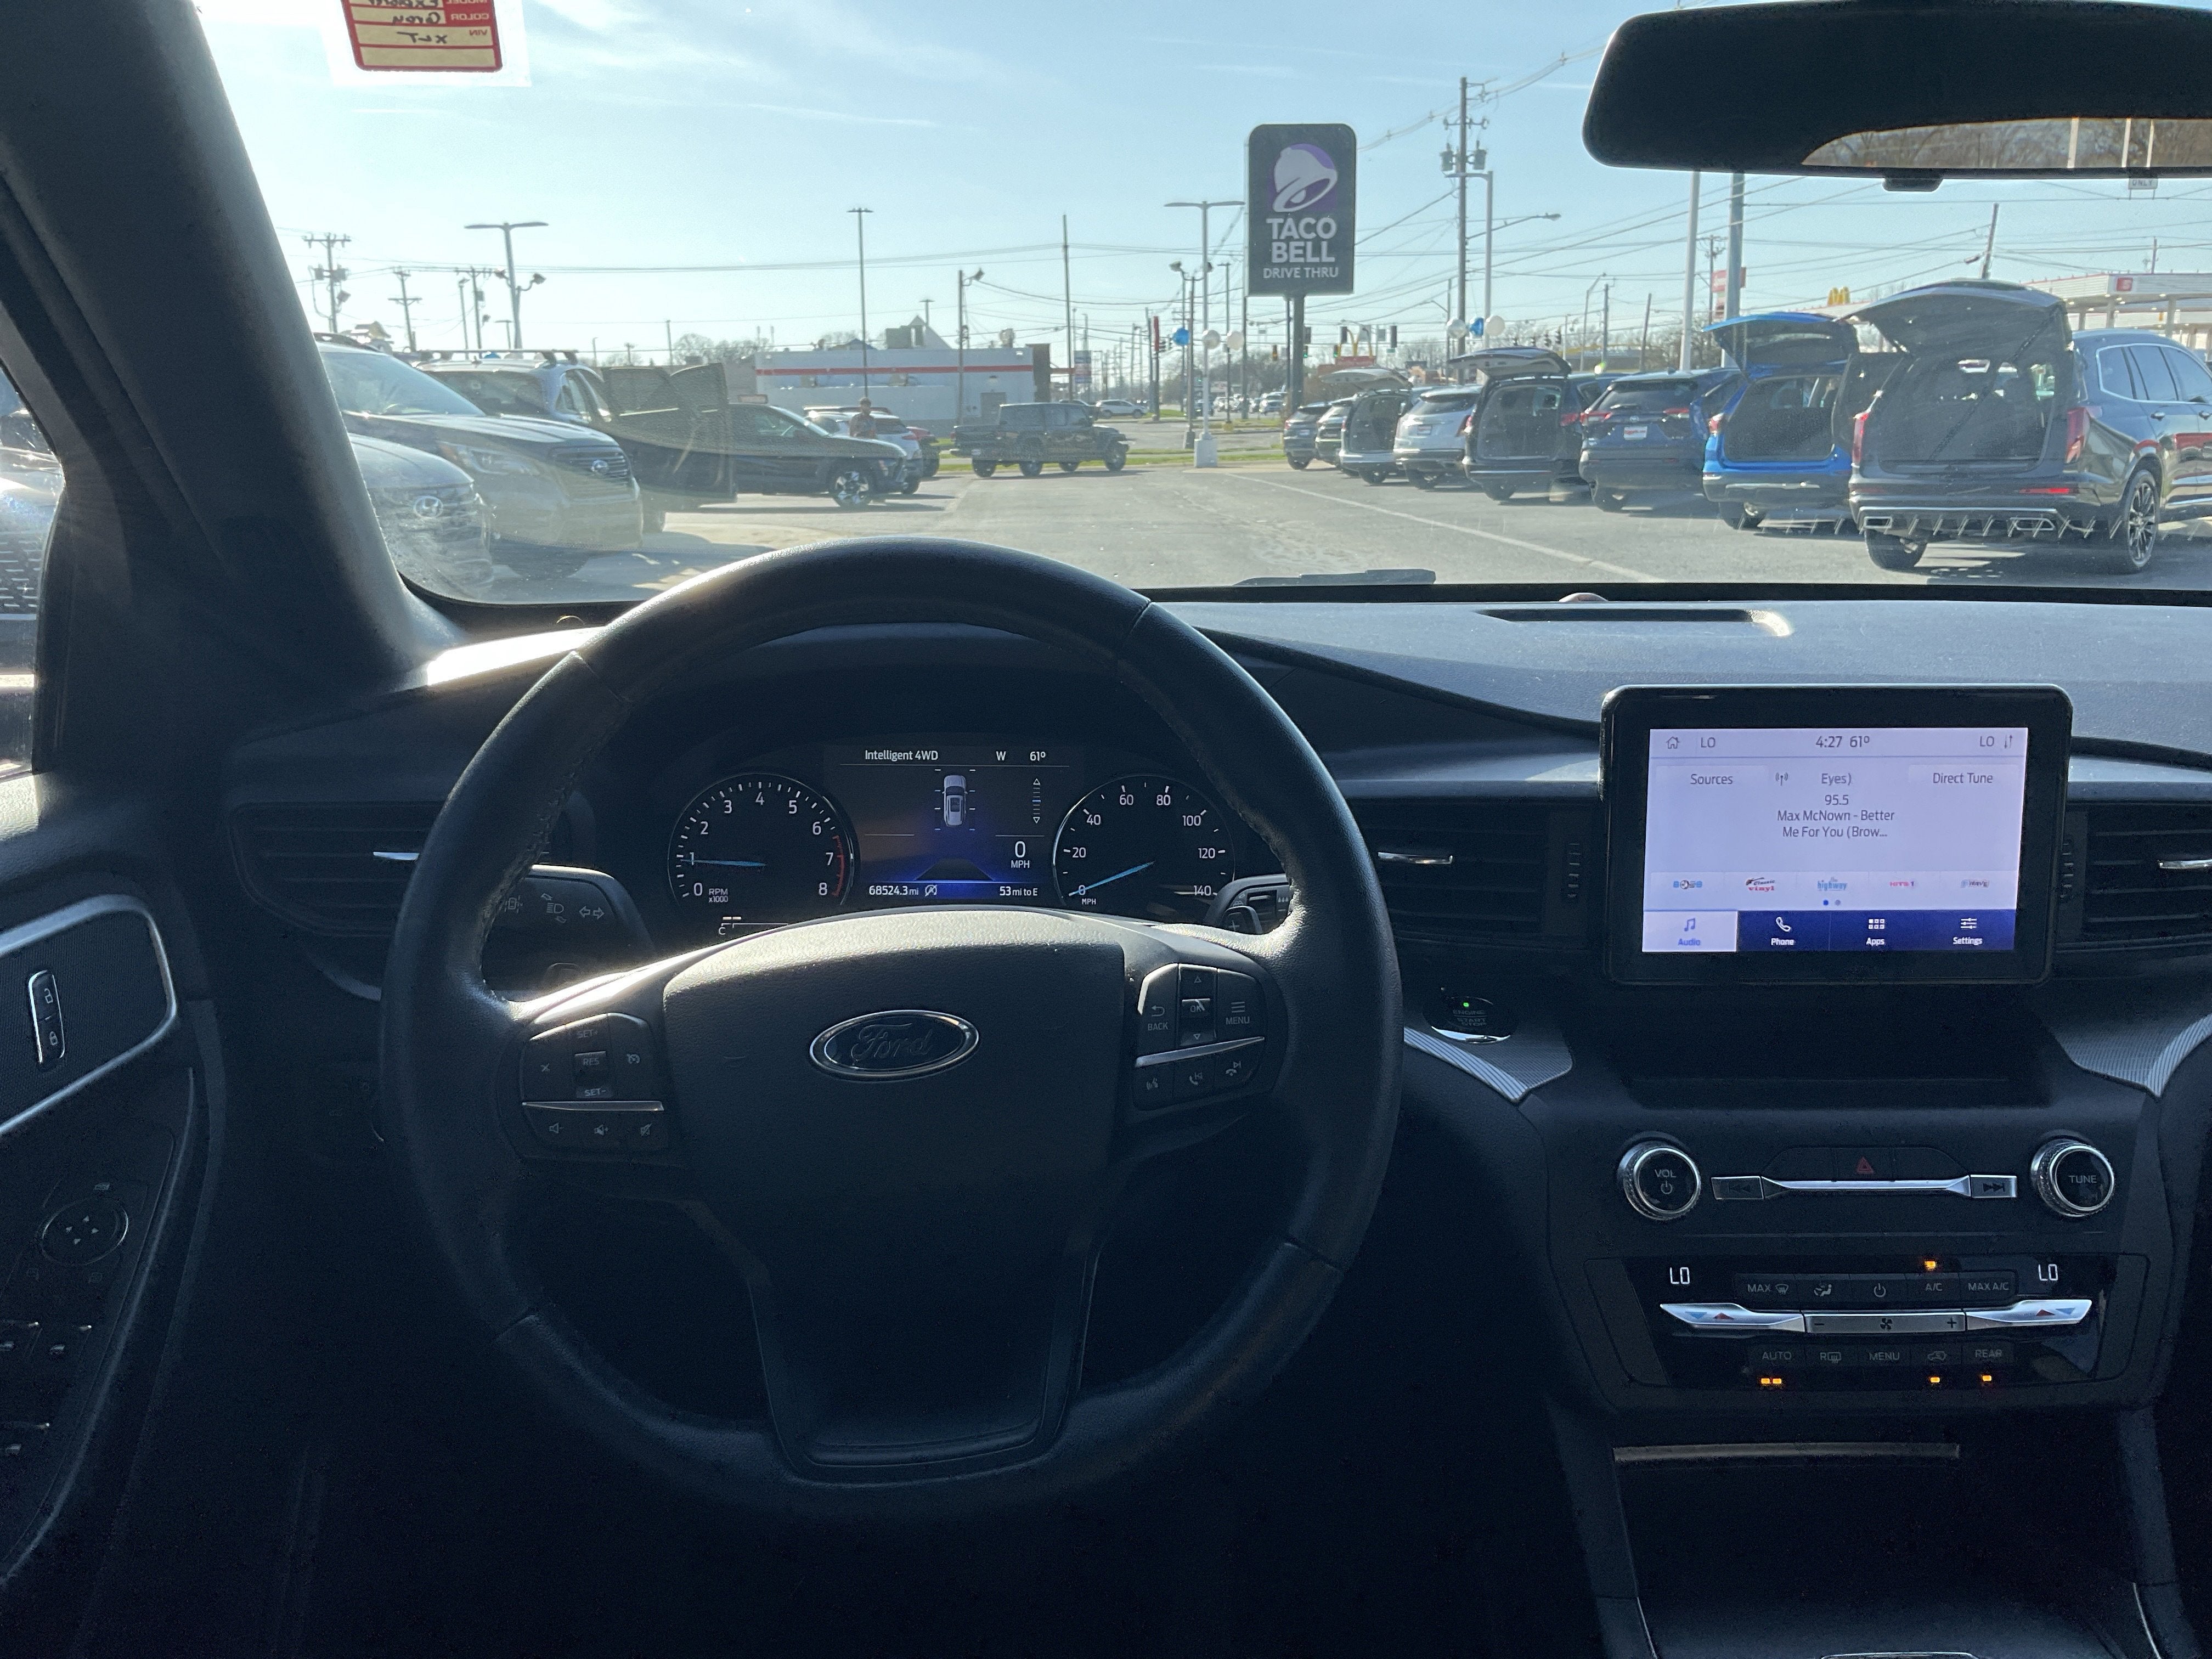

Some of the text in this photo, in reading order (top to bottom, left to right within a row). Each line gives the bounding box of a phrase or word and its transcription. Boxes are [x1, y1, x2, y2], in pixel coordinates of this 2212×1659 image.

[1266, 218, 1337, 239] TACO
[1271, 241, 1335, 263] BELL
[1263, 267, 1338, 278] DRIVE THRU
[1701, 737, 1716, 748] LO
[1815, 736, 1842, 748] 4:27
[1979, 736, 1995, 747] LO
[865, 749, 939, 761] Intelligent 4WD
[996, 751, 1006, 761] W
[1690, 774, 1733, 785] Sources
[1821, 773, 1852, 786] Eyes)
[1933, 772, 1993, 783] Direct Tune
[755, 792, 765, 806] 4
[1119, 794, 1134, 806] 60
[1156, 794, 1171, 806] 80
[1825, 794, 1849, 805] 95.5
[724, 800, 733, 813] 3
[789, 800, 798, 814] 5
[1086, 814, 1101, 825] 40
[1182, 815, 1201, 826] 100
[1777, 810, 1801, 821] Max
[1803, 810, 1850, 821] McNown
[1861, 810, 1895, 821] Better
[700, 822, 709, 835] 2
[812, 822, 821, 836] 6
[1782, 826, 1887, 839] Me For You (Brow...
[1014, 840, 1026, 858] 0
[1072, 847, 1086, 858] 20
[1198, 848, 1216, 859] 120
[826, 853, 833, 865] 7
[1011, 860, 1030, 868] MPH
[693, 882, 703, 896] 0
[818, 882, 828, 896] 8
[868, 885, 908, 896] 68524.3
[1193, 885, 1211, 896] 140
[1817, 879, 1847, 891] highway
[999, 886, 1038, 896] 53 mi to E
[718, 927, 726, 935] C
[1678, 938, 1701, 946] Audio
[1866, 937, 1885, 946] Apps
[1953, 936, 1983, 946] Settings
[1226, 1016, 1250, 1025] MENU
[1147, 1022, 1169, 1031] BACK
[850, 1022, 934, 1061] Ford
[583, 1057, 600, 1065] RES
[1655, 1169, 1677, 1178] VOL
[2068, 1175, 2097, 1183] TUNE
[1669, 1267, 1690, 1284] LO
[2038, 1263, 2058, 1281] LO
[1747, 1284, 1771, 1293] MAX
[1925, 1283, 1943, 1291] A/C
[1968, 1282, 2009, 1291] MAX A/C
[1762, 1351, 1792, 1361] AUTO
[1869, 1352, 1900, 1361] MENU
[1974, 1349, 2002, 1358] REAR
